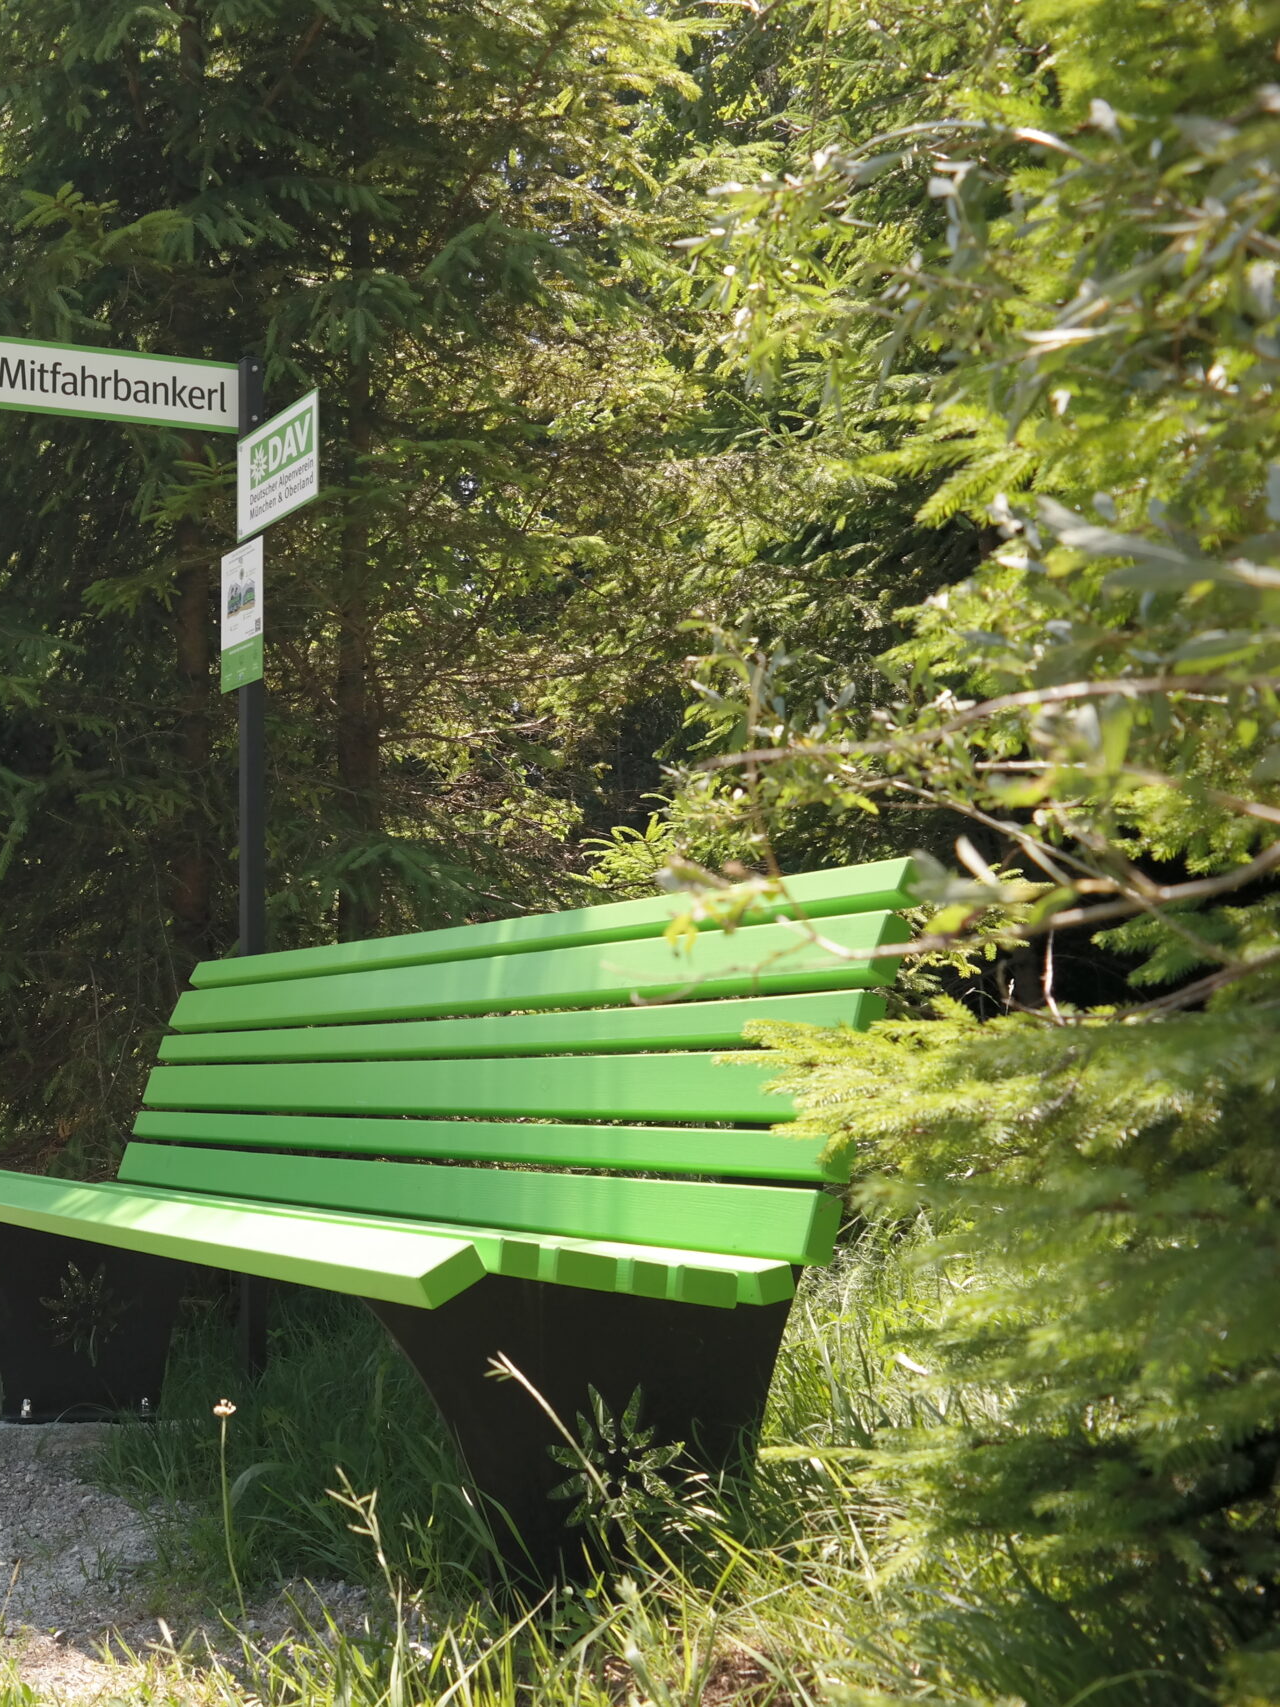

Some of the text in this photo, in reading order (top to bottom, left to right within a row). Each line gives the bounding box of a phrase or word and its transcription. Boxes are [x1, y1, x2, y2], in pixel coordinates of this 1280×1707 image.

[268, 413, 311, 473] DAV
[249, 458, 314, 506] Deutscher Alpenverein
[249, 471, 314, 521] München & Oberland
